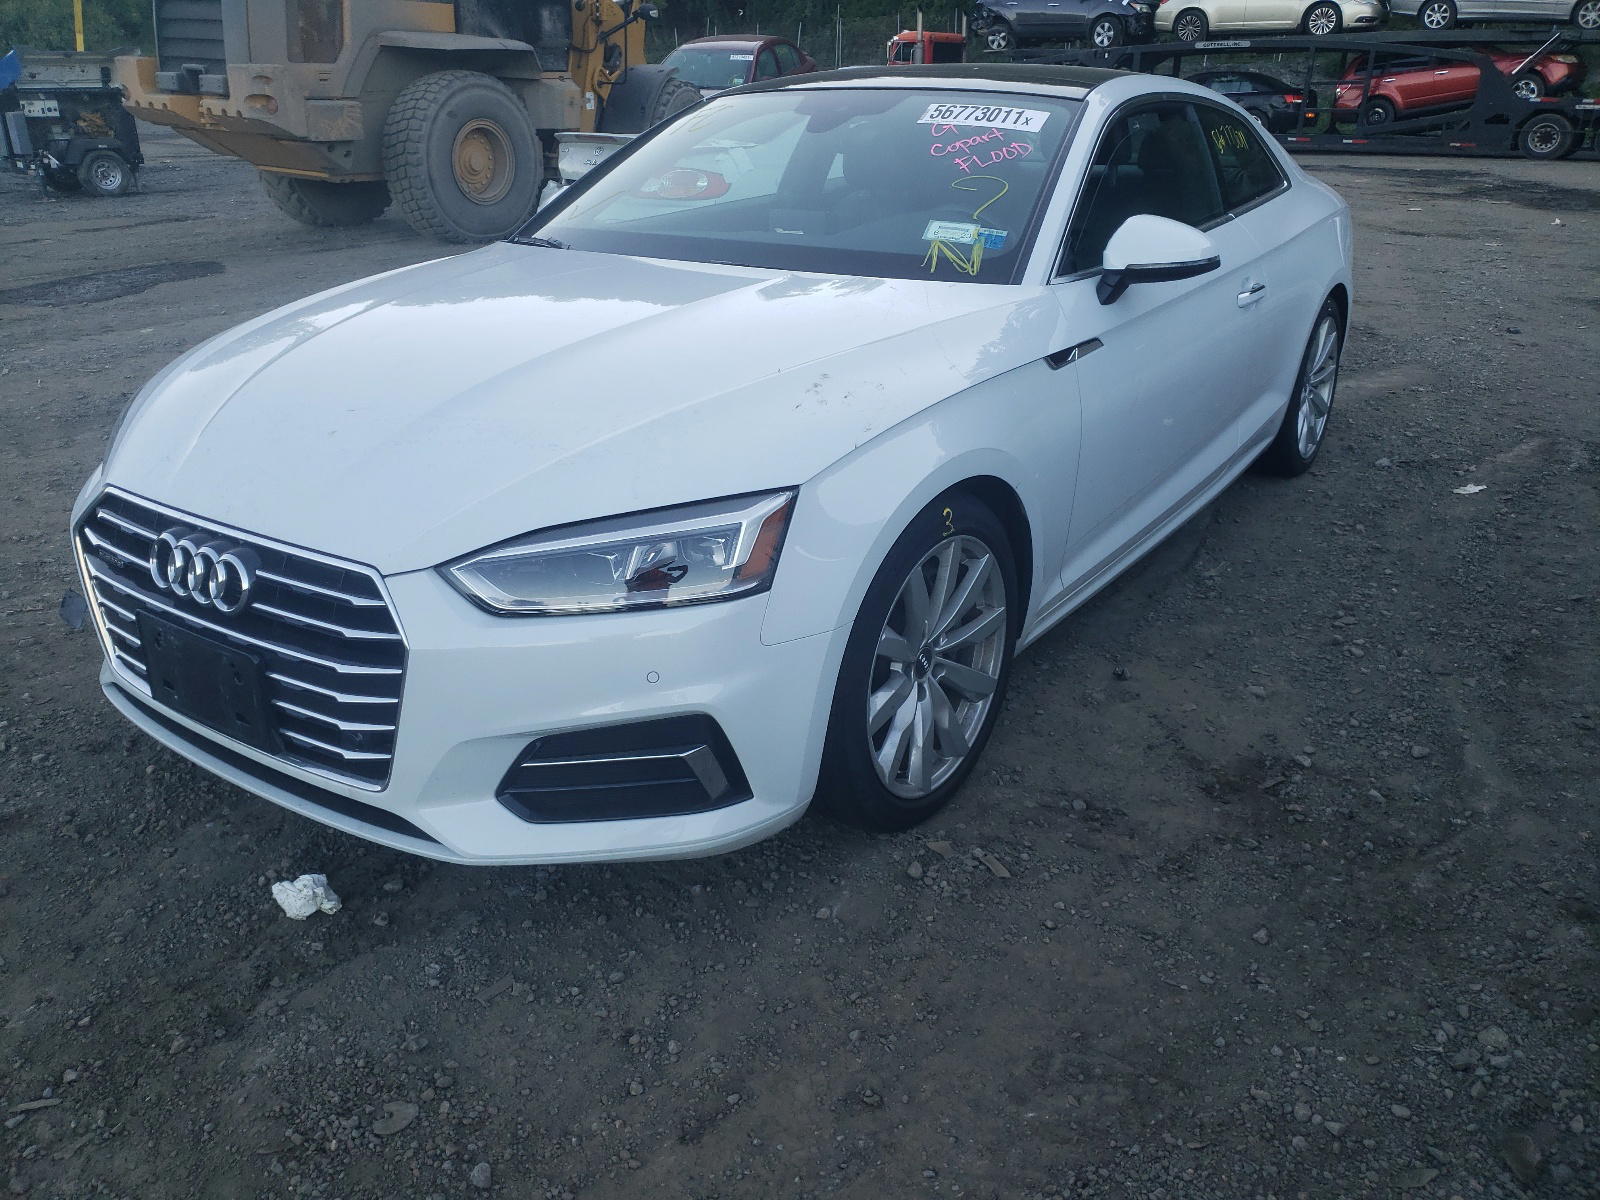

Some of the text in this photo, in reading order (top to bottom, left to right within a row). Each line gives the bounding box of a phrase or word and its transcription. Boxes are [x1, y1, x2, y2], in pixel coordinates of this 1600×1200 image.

[930, 128, 1004, 156] Copart
[954, 142, 1033, 174] FLOOD
[941, 507, 955, 536] 3
